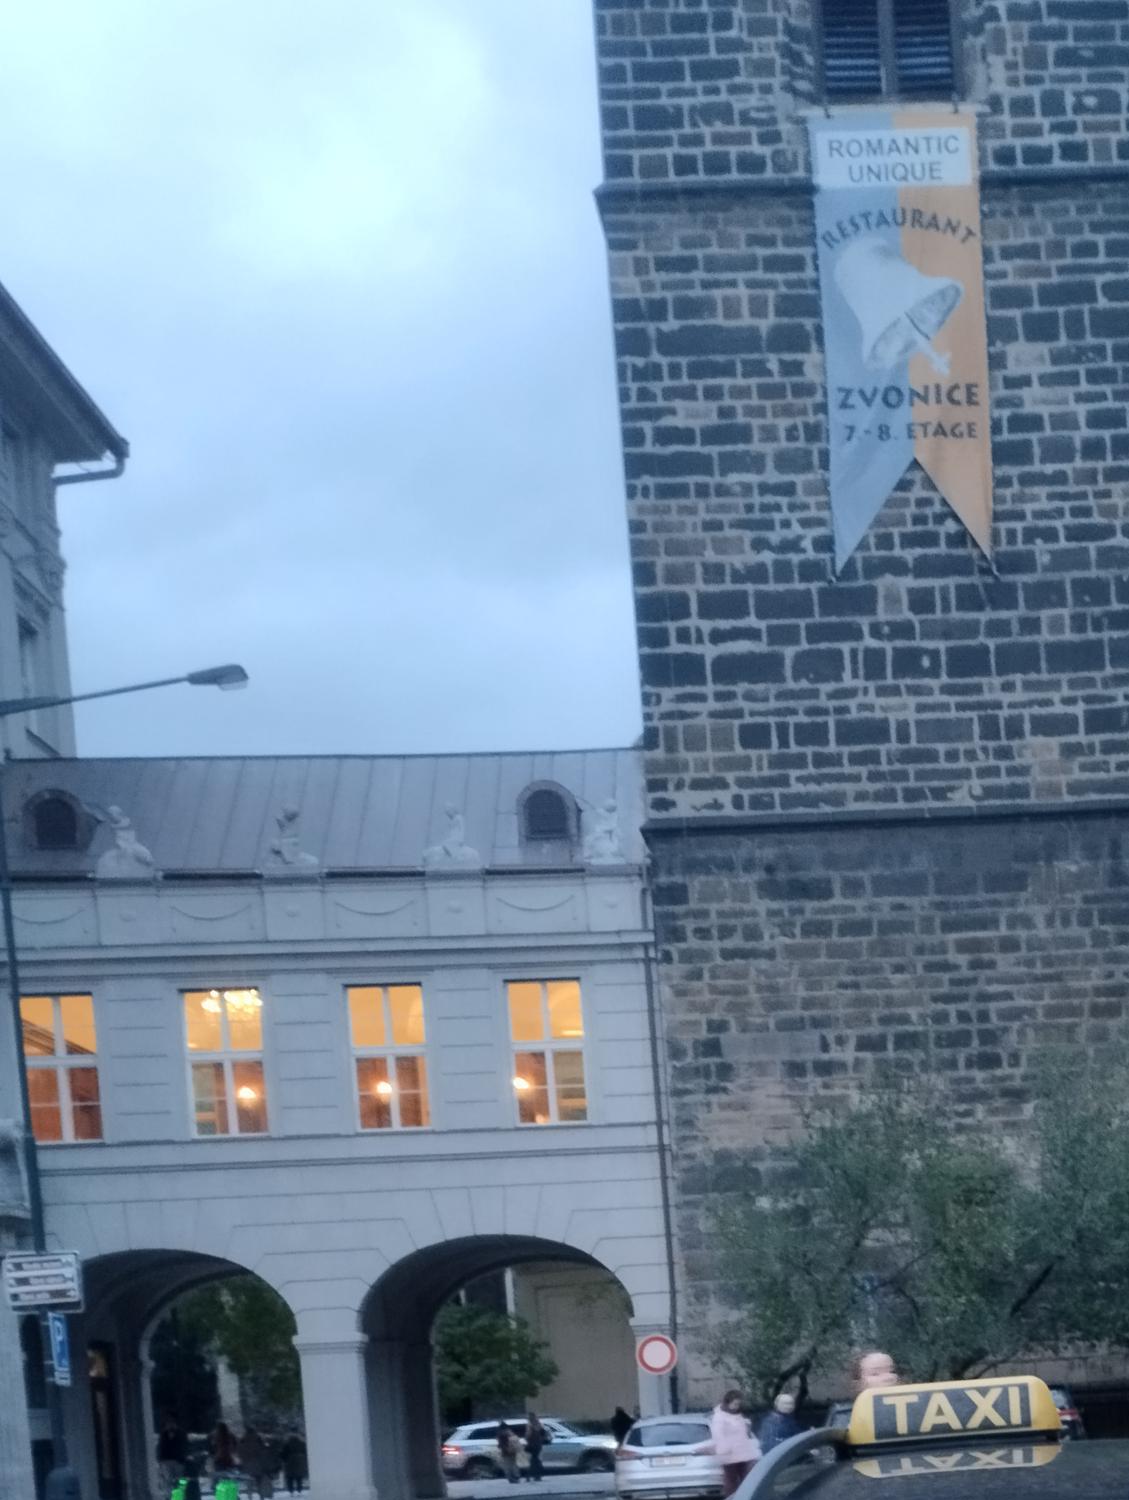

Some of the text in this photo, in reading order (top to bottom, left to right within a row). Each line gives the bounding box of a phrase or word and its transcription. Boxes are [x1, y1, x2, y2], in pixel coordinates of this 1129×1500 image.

[827, 134, 960, 158] ROMANTIC
[848, 161, 943, 183] UNIQUE
[820, 206, 977, 249] RESTAURANT
[837, 383, 980, 410] ZVONICE
[905, 421, 978, 440] ETAGE
[882, 1385, 1023, 1435] TAXI
